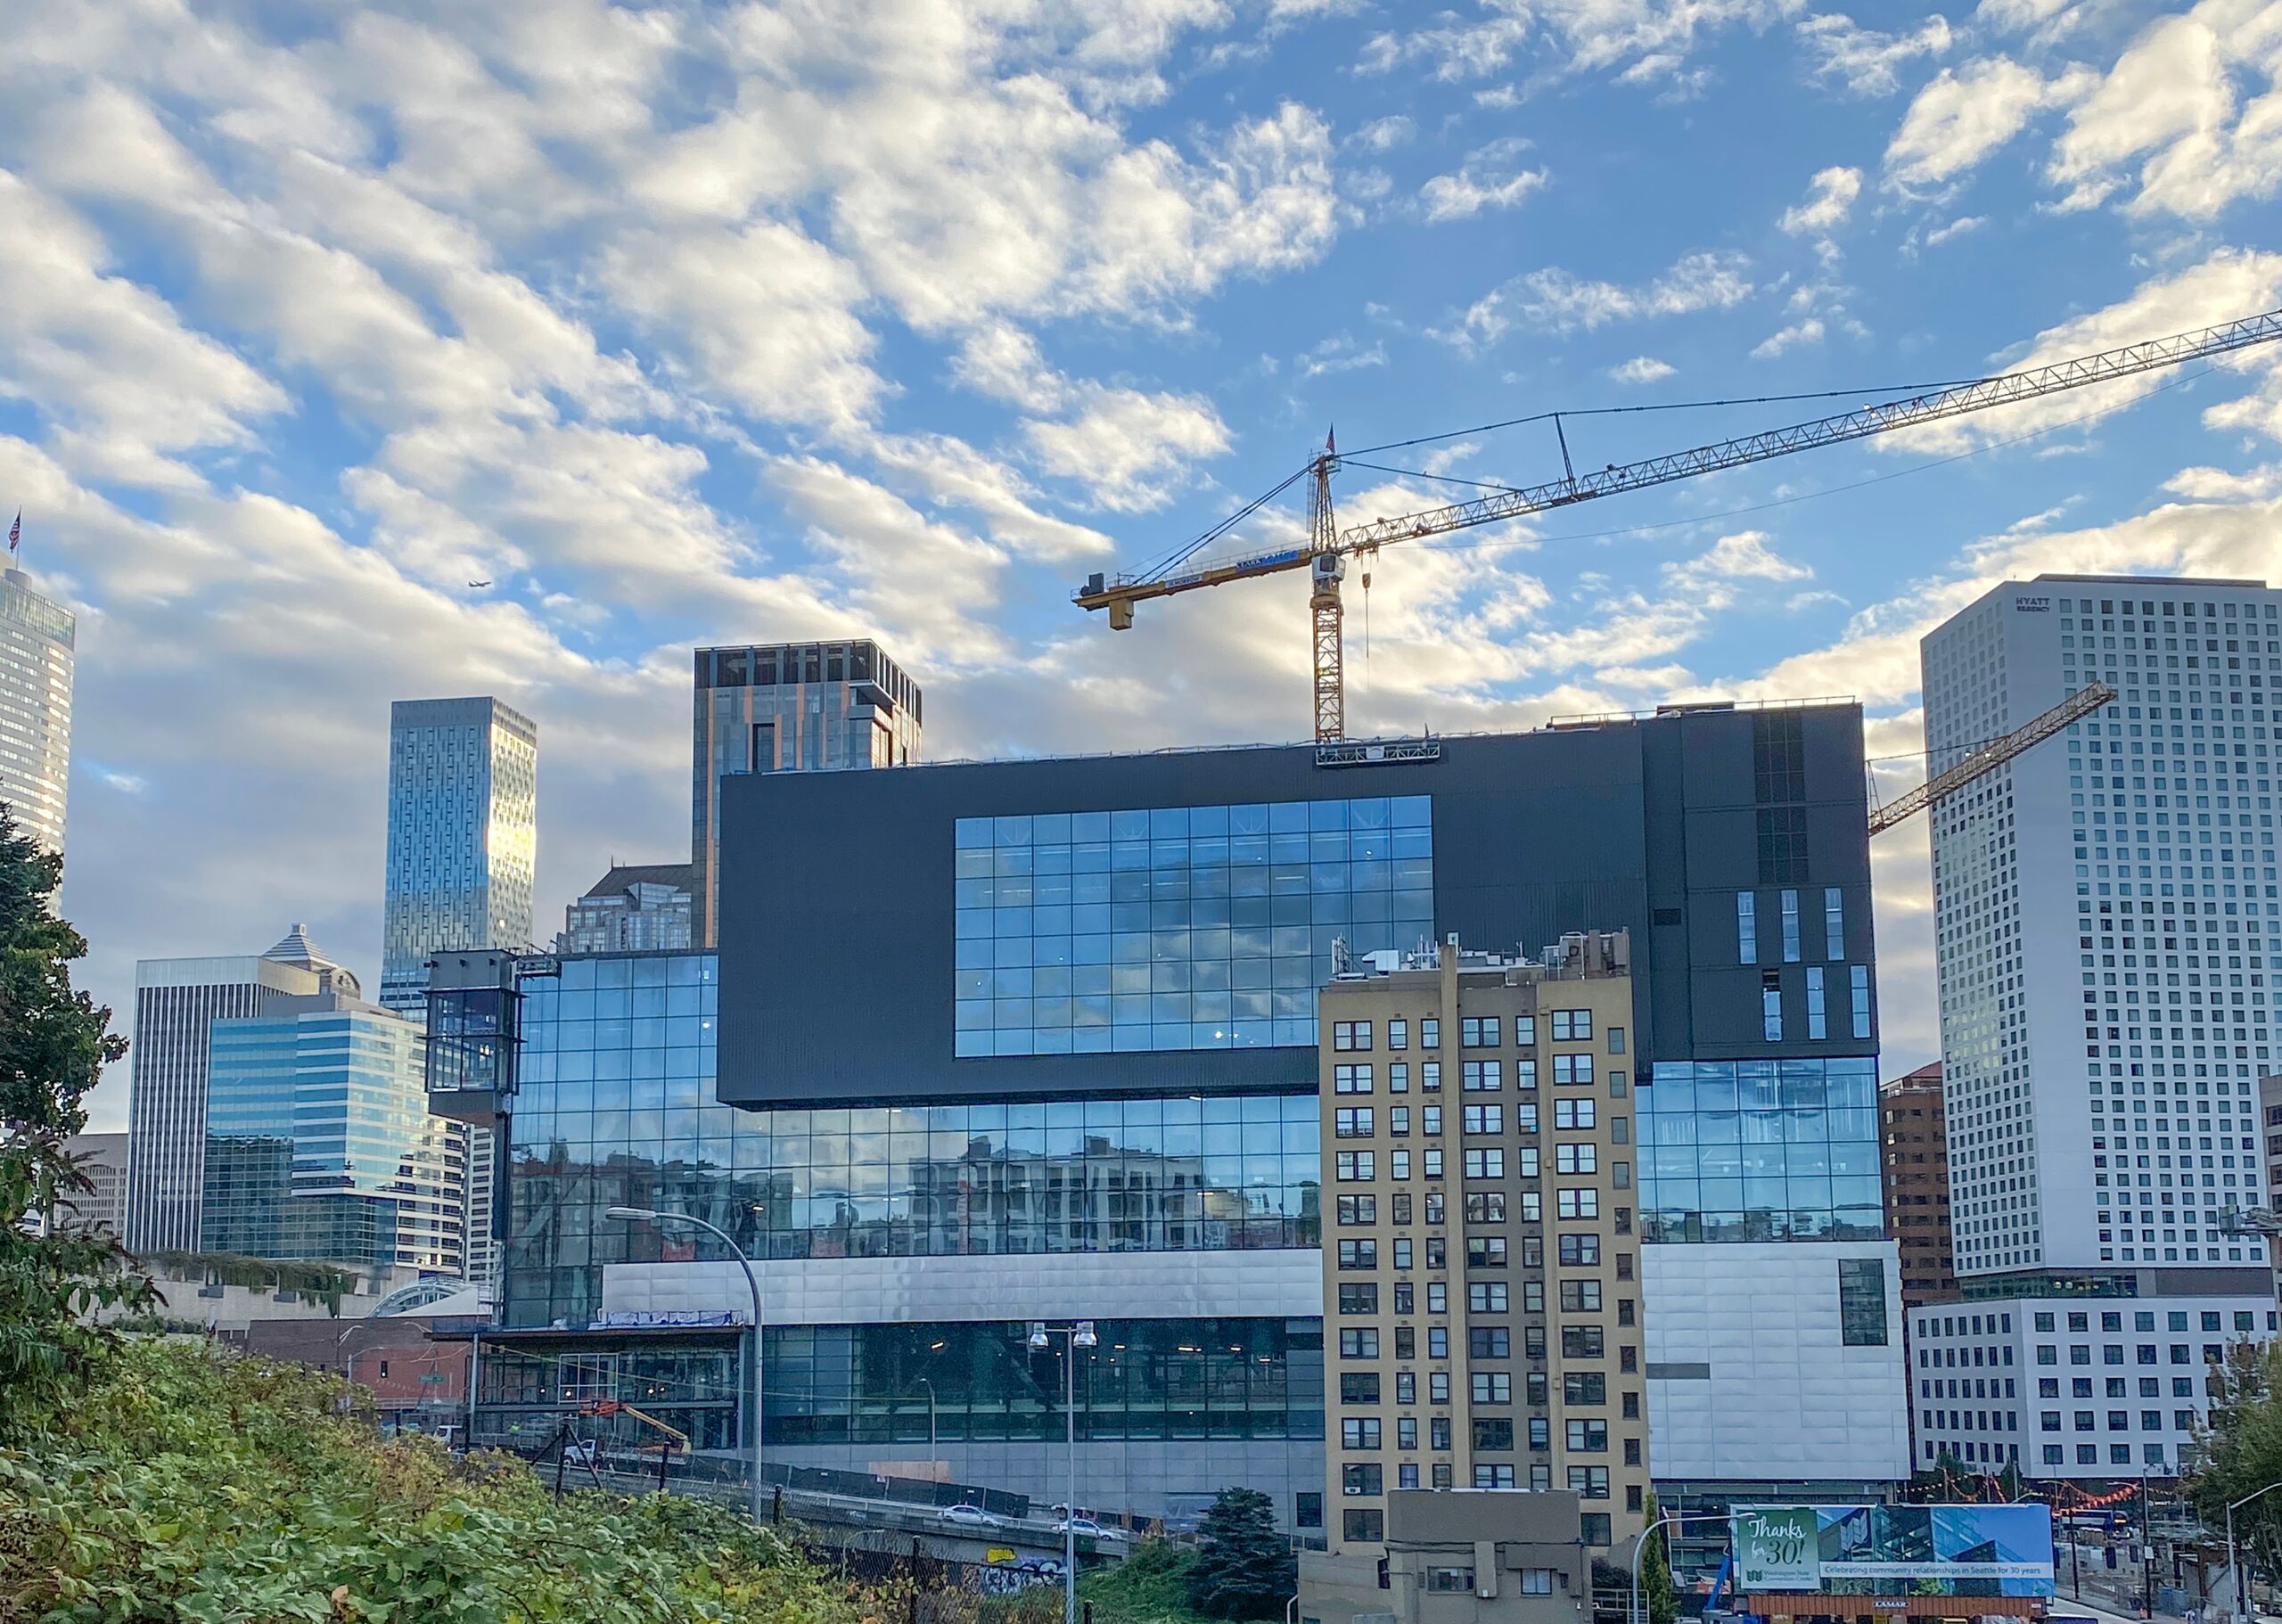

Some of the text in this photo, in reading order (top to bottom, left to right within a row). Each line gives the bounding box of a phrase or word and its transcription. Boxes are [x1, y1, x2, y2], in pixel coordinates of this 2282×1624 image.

[2015, 597, 2050, 605] HYATT
[1748, 1515, 1807, 1539] Thanks
[1752, 1538, 1805, 1565] for 30!
[1825, 1565, 2041, 1576] Celebrating community relationships in Seattle for 30 years
